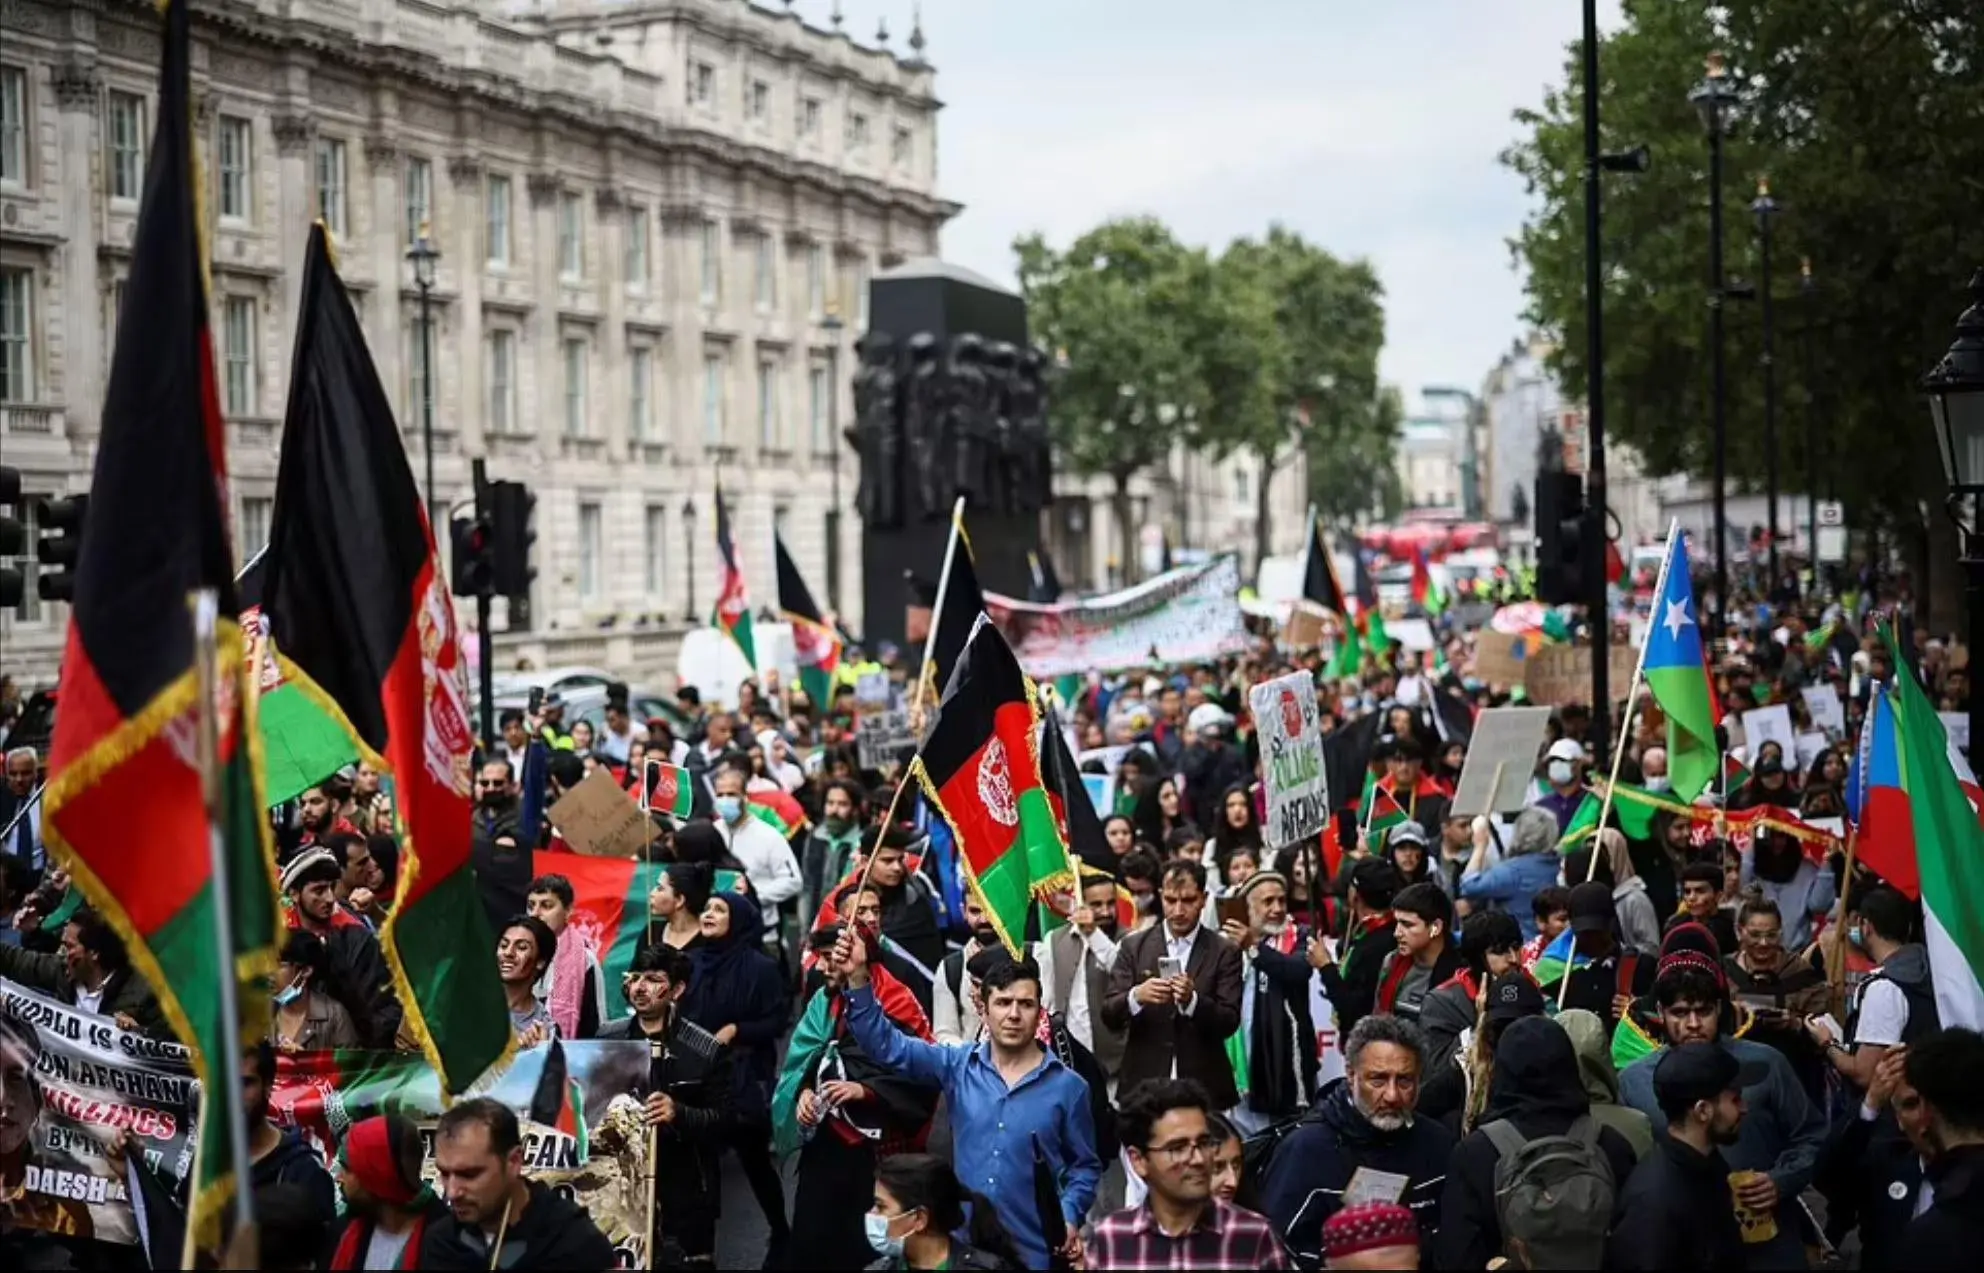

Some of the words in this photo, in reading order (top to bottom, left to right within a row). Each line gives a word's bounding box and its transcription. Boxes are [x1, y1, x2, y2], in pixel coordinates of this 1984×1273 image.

[5, 992, 81, 1041] WORLD
[89, 1024, 113, 1051] IS
[36, 1050, 70, 1081] ON
[42, 1086, 177, 1140] KILLINGS
[47, 1126, 73, 1150] BY
[25, 1165, 109, 1204] DAESH
